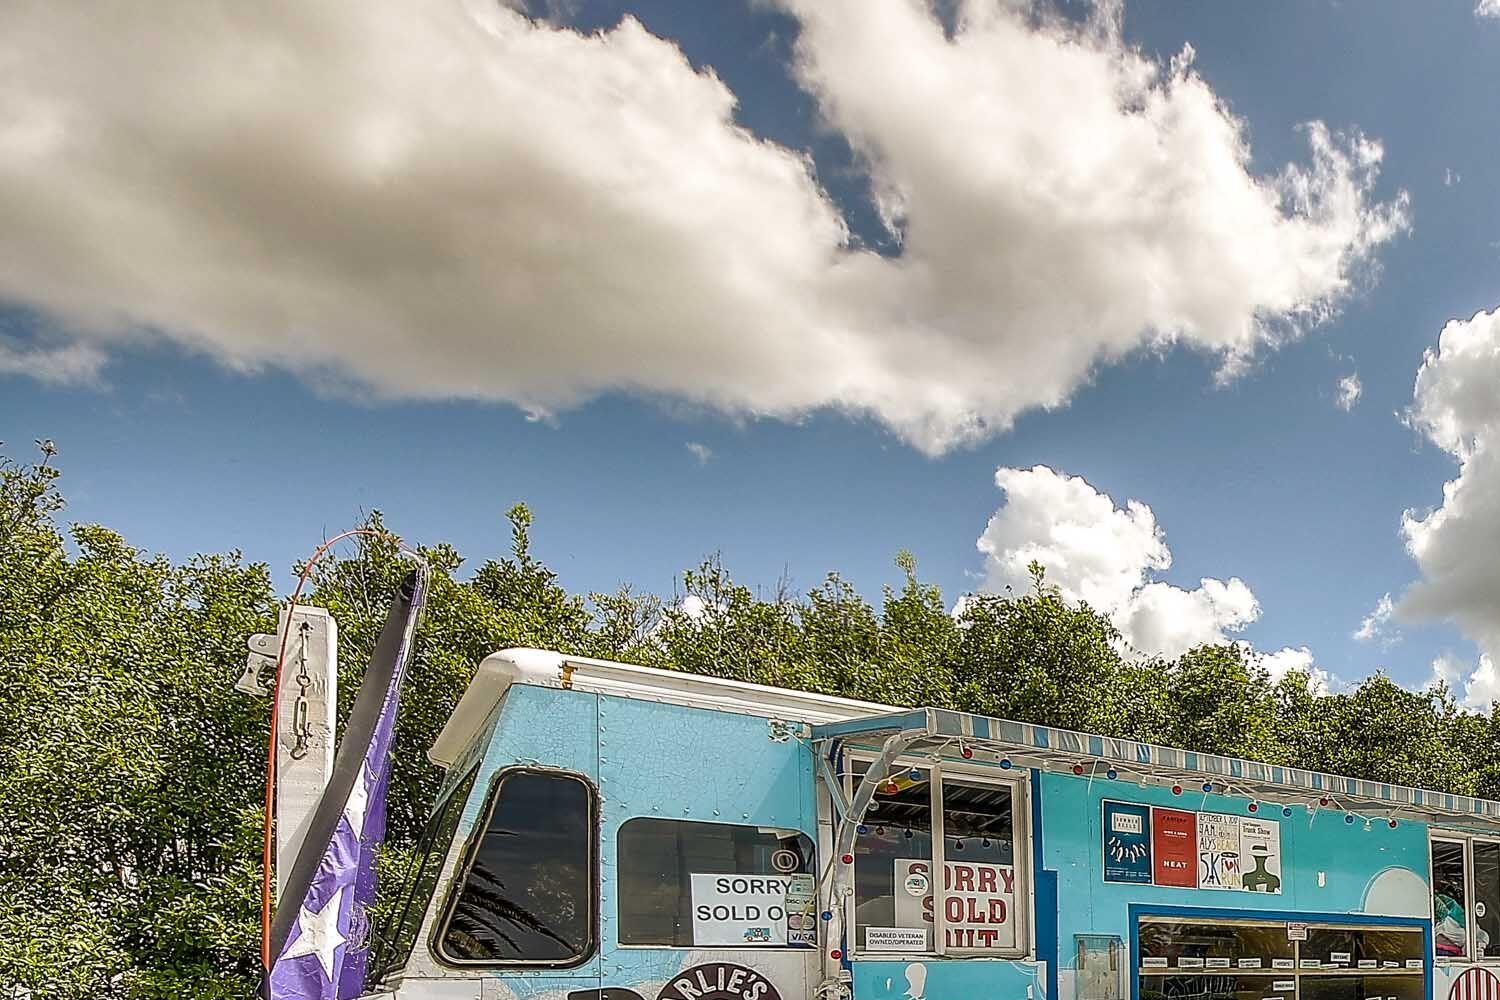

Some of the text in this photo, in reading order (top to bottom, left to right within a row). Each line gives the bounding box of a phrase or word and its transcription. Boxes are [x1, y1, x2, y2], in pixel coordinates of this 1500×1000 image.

[1257, 827, 1271, 836] Show
[1200, 852, 1221, 885] 5K
[716, 878, 792, 895] SORRY
[697, 905, 761, 921] SOLD
[922, 895, 1007, 924] SOLD
[945, 928, 999, 948] UT
